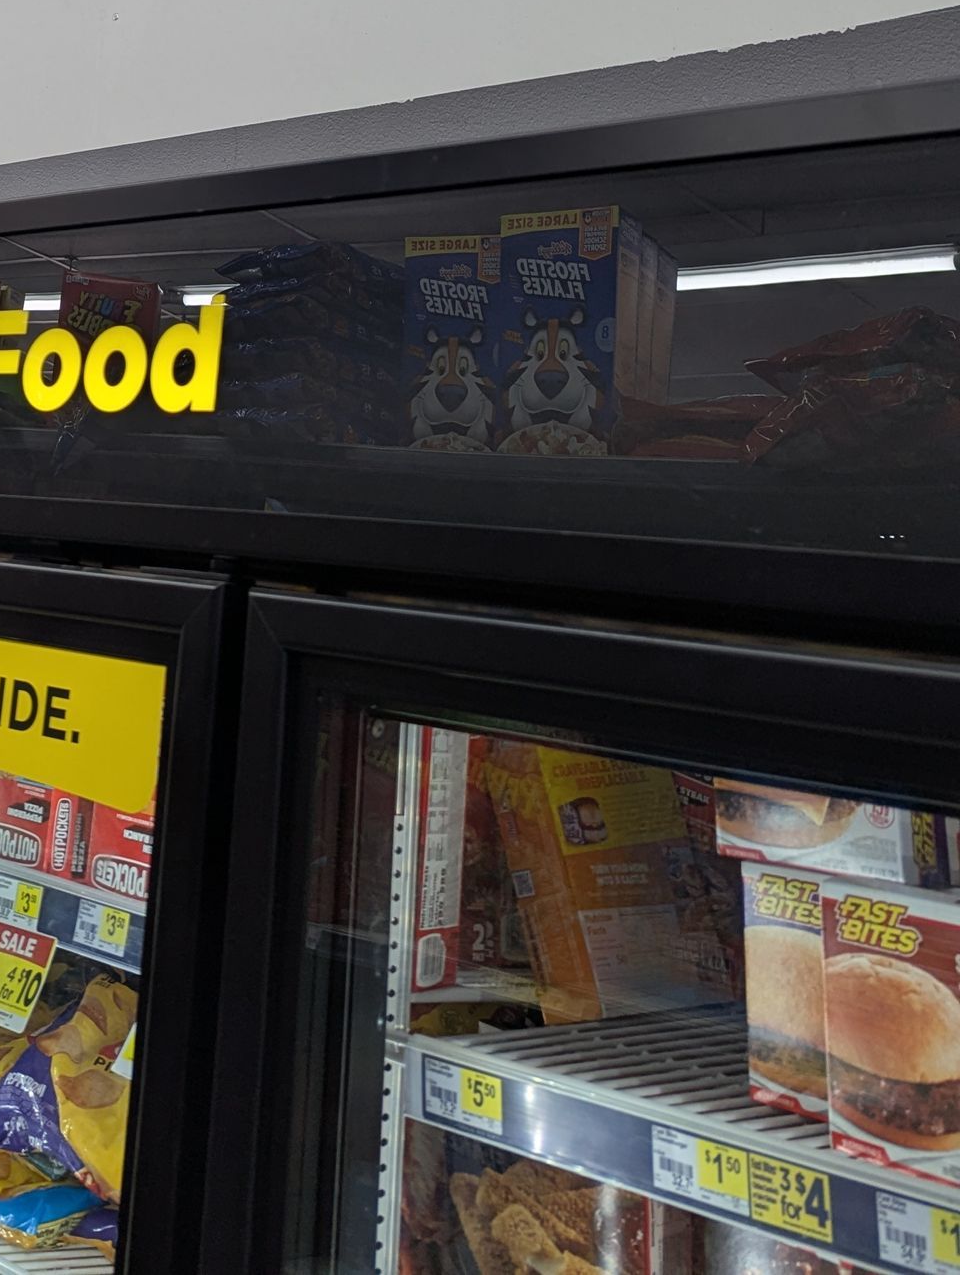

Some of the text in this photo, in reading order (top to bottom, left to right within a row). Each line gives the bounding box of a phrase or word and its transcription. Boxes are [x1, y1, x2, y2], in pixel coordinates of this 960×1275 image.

[679, 787, 710, 804] STEAK
[15, 833, 38, 862] HOT
[53, 802, 70, 867] HOT POCKETS
[758, 875, 819, 903] FAST
[840, 895, 908, 927] FAST
[841, 919, 920, 954] BITES
[7, 966, 18, 982] 4
[17, 968, 43, 1007] $10
[779, 1167, 791, 1192] 3
[780, 1195, 803, 1221] for
[795, 1172, 829, 1229] $4
